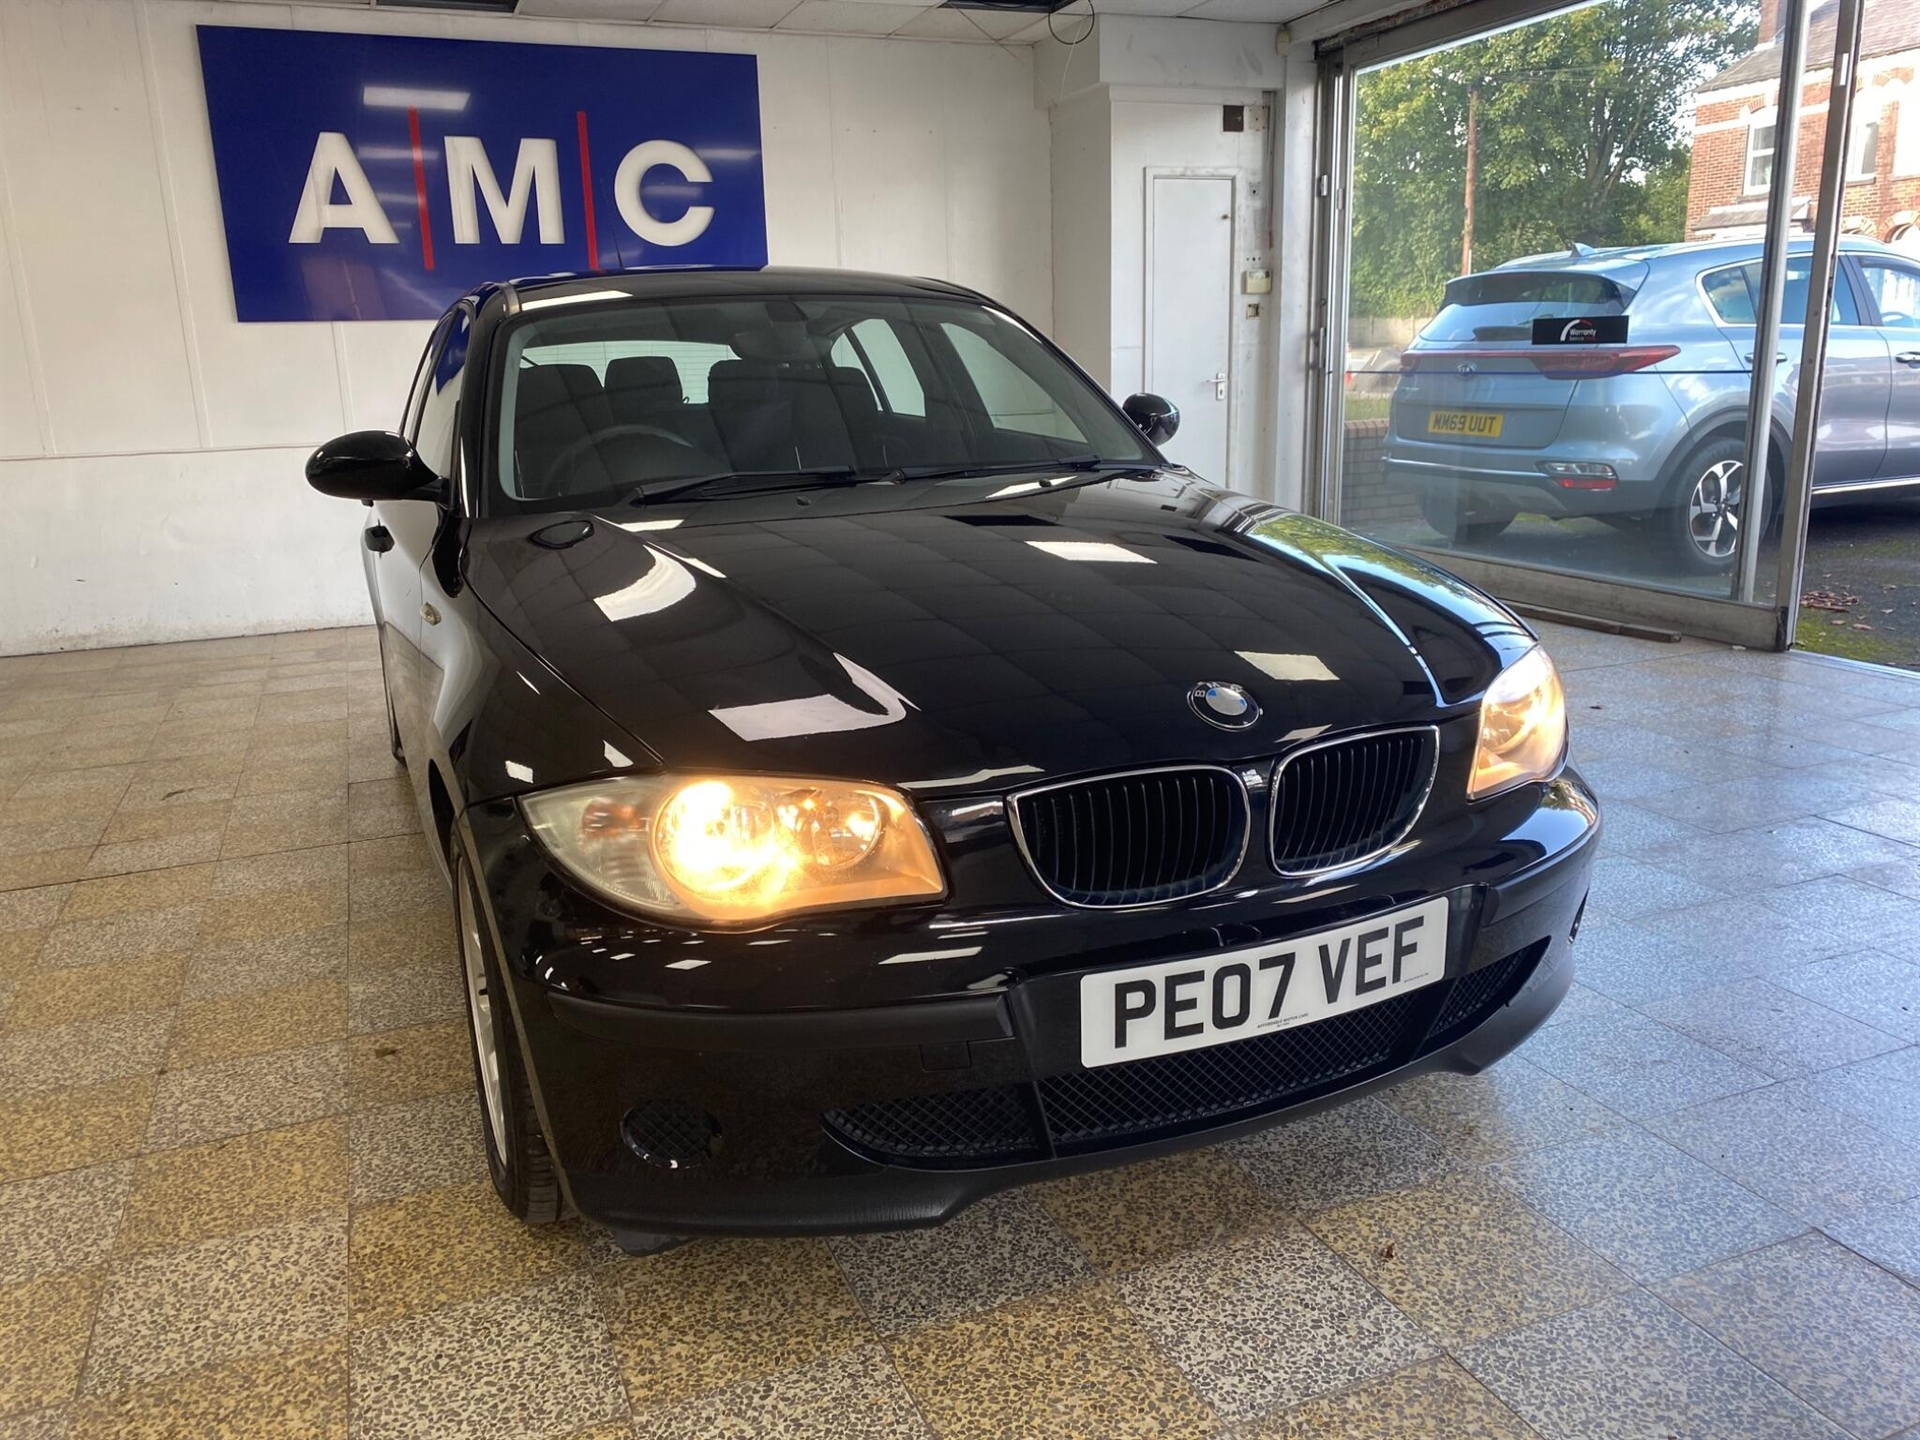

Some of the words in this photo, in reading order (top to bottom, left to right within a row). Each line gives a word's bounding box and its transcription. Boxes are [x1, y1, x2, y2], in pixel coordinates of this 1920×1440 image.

[1468, 415, 1497, 434] UUT
[1114, 951, 1296, 1049] PE07
[1318, 915, 1425, 1004] VEF
